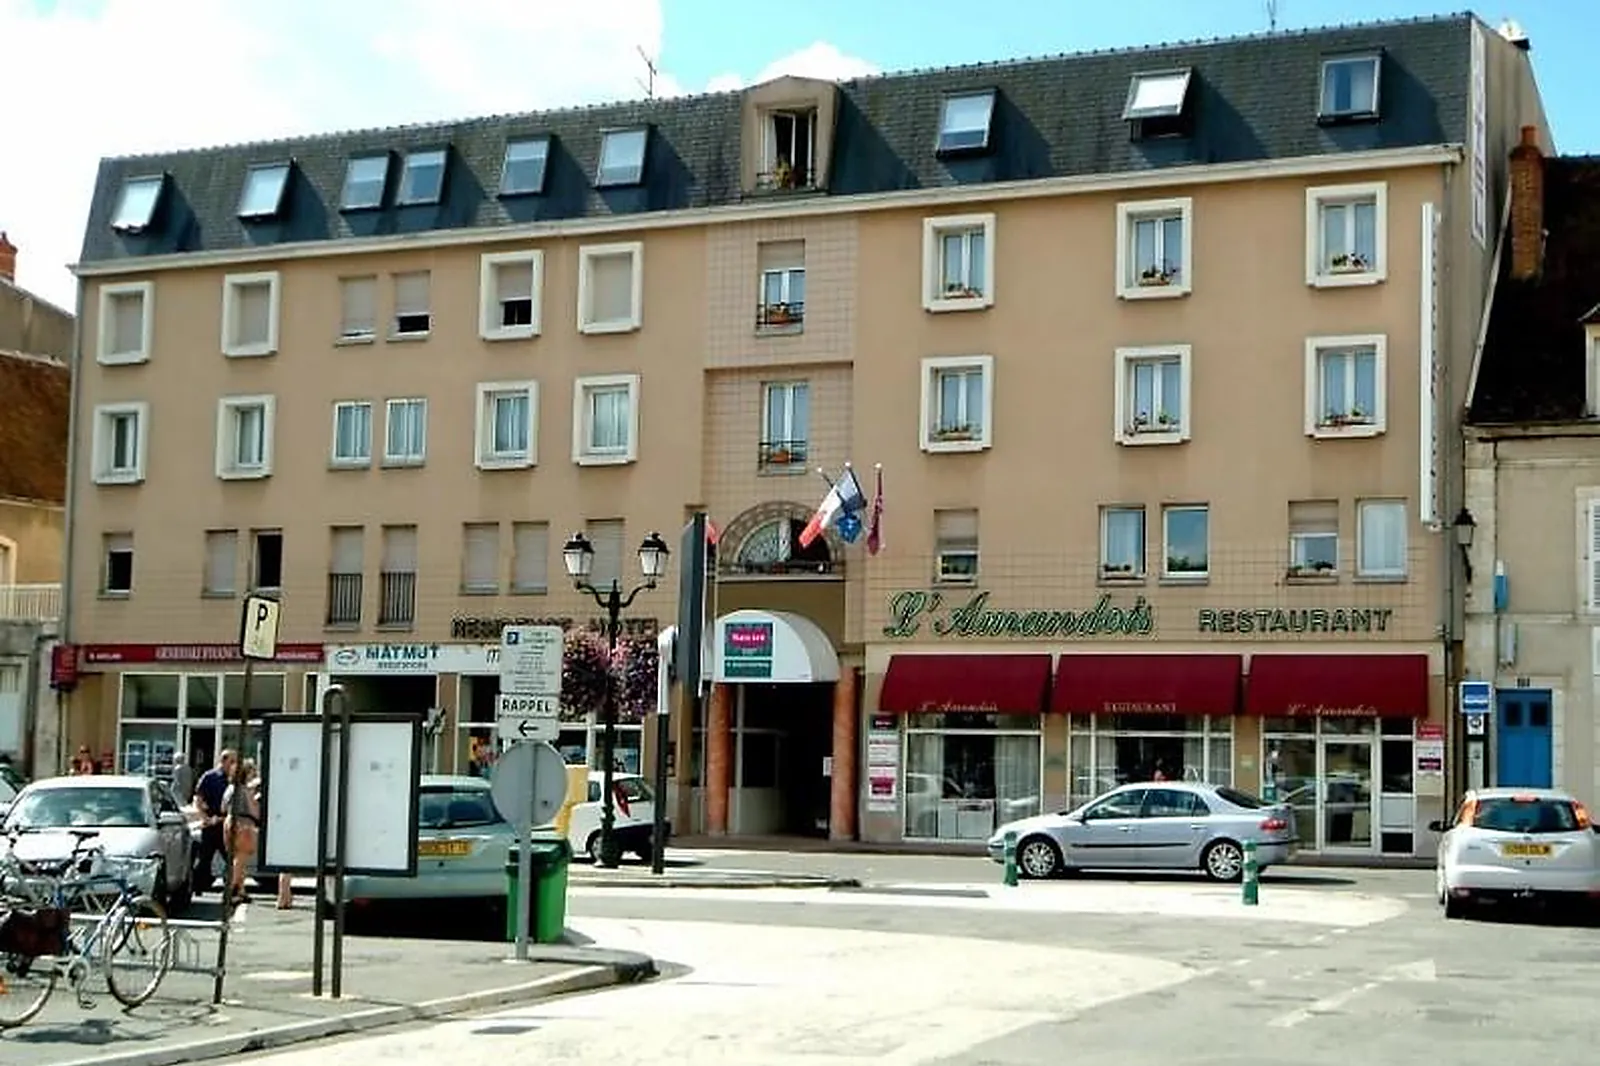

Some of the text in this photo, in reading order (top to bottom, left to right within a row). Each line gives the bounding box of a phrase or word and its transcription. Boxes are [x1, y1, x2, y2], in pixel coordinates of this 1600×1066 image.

[255, 603, 268, 631] P
[883, 590, 1154, 638] L'Amandois
[1199, 608, 1393, 633] RESTAURANT
[502, 699, 553, 713] RAPPEL
